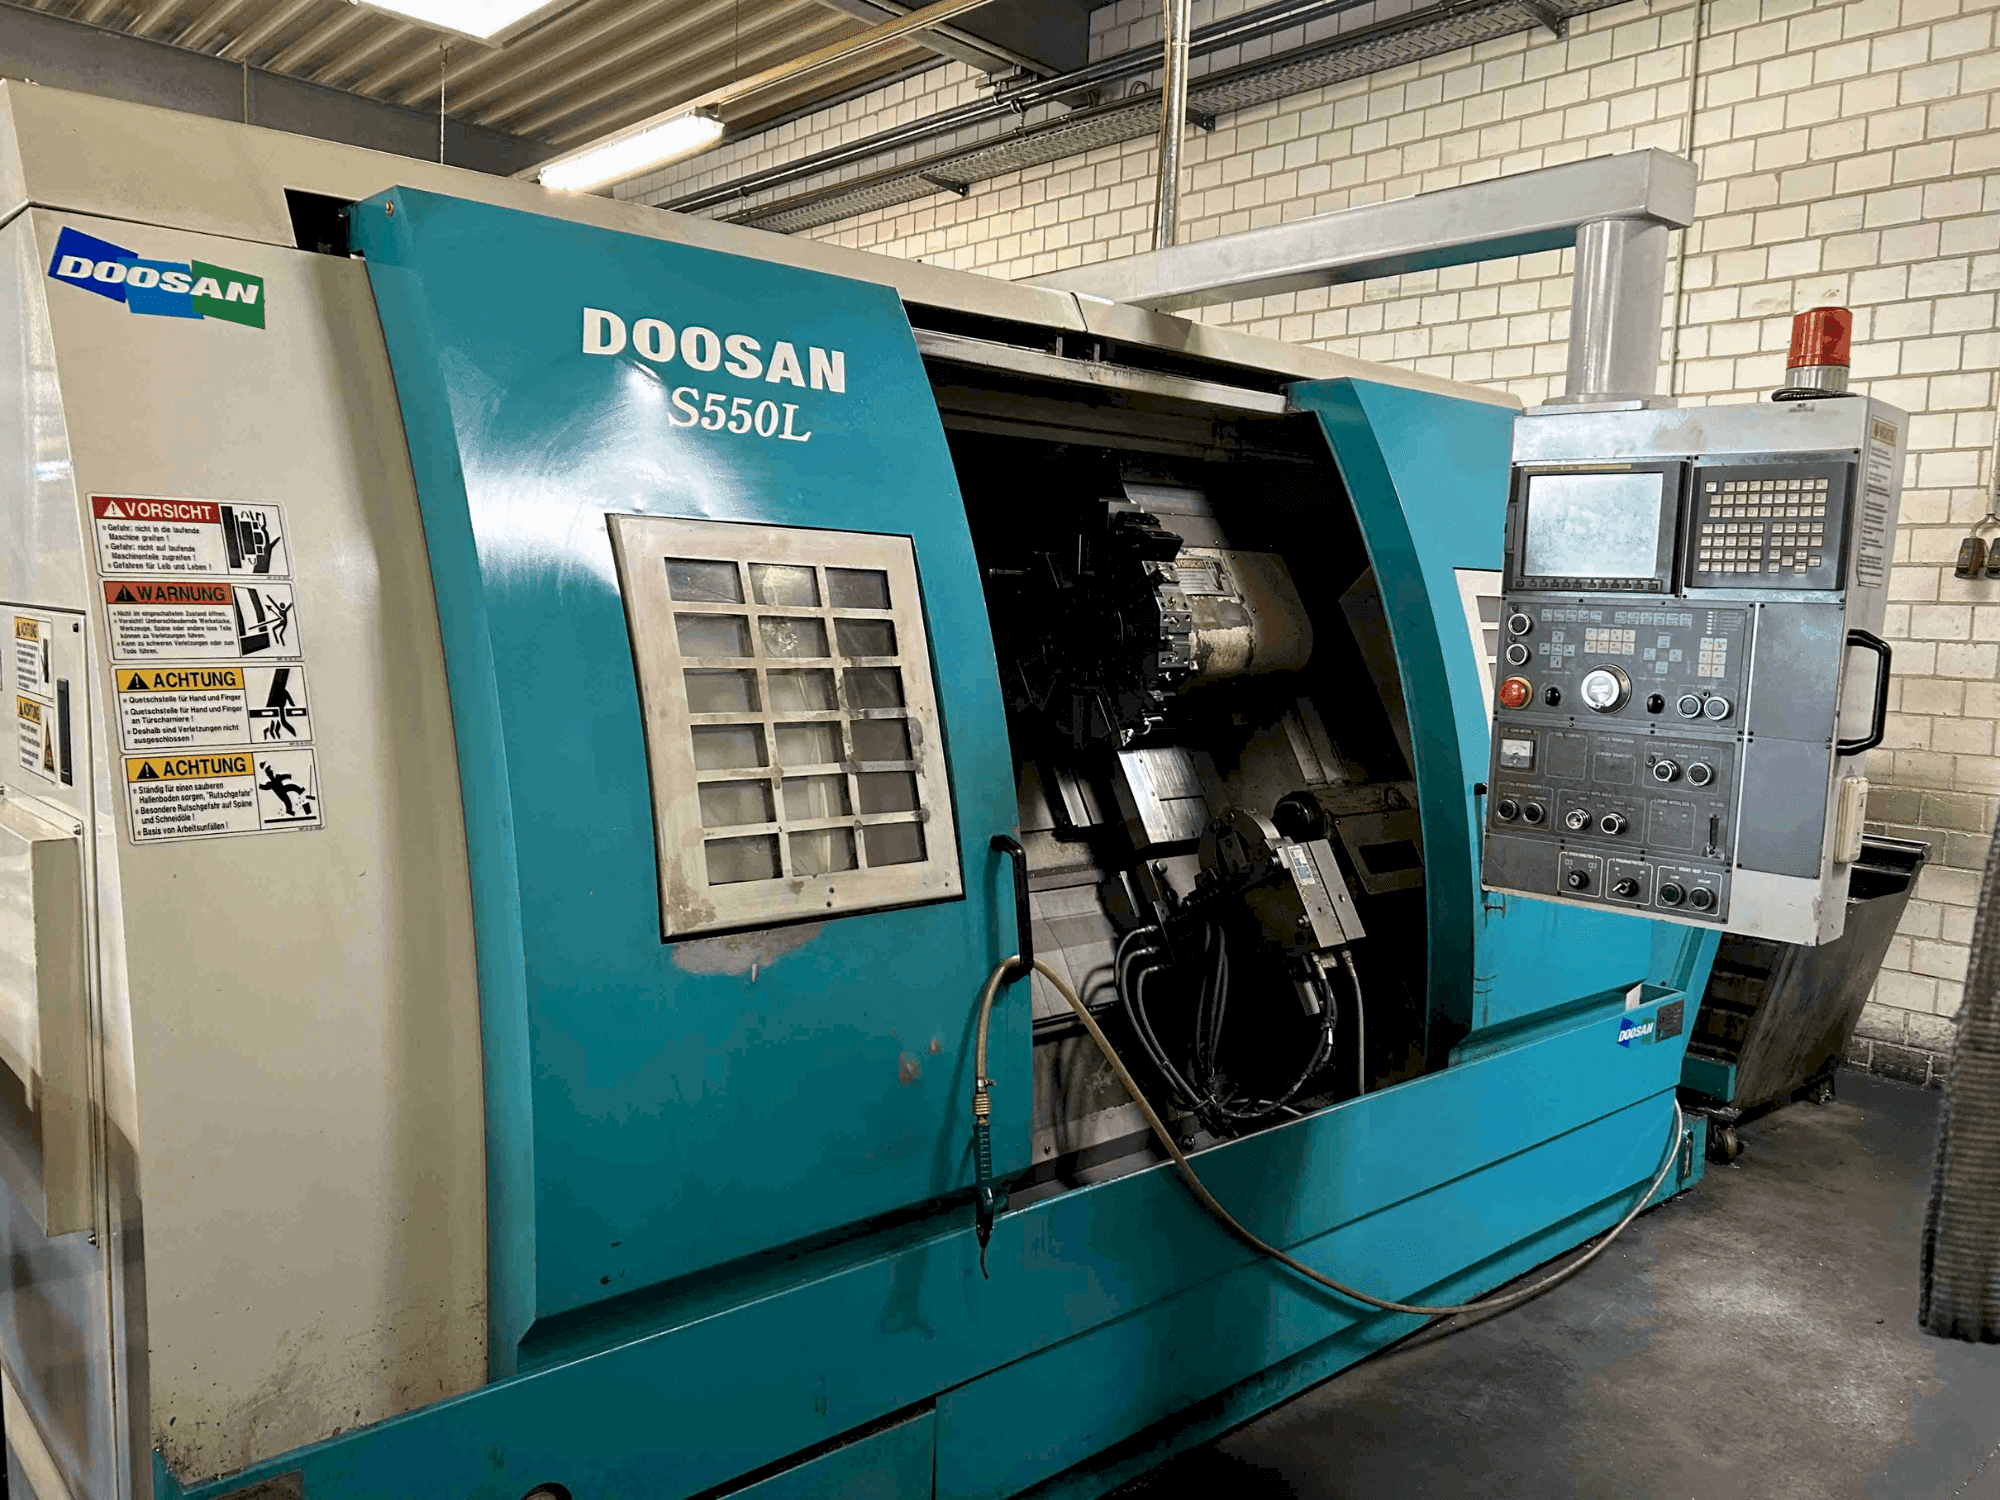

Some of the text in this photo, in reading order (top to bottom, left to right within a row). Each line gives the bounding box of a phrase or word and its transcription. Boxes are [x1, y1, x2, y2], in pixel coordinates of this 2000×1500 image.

[56, 255, 259, 304] DOOSAN
[582, 307, 845, 393] DOOSAN
[668, 386, 811, 442] S550L
[125, 501, 212, 520] VORSICHT
[108, 524, 132, 532] Gefahr:
[112, 552, 159, 560] Maschinenteile
[162, 553, 191, 561] zugreifen
[136, 586, 225, 601] WARNUNG
[154, 671, 236, 688] ACHTUNG
[134, 736, 189, 744] ausgeschlossen
[163, 757, 246, 776] ACHTUNG
[139, 786, 163, 794] Ständig
[195, 782, 223, 790] sauberen
[140, 795, 179, 803] Hallenboden
[206, 788, 253, 800] "Rutschgefahr"
[141, 806, 176, 814] Besondere
[178, 802, 220, 812] Rutschgefahr
[233, 800, 252, 808] Späne
[156, 814, 191, 824] Schneidöle
[143, 828, 161, 836] Basis
[177, 822, 224, 832] Arbeitsunfällen
[1618, 1022, 1653, 1042] DOOSAN
